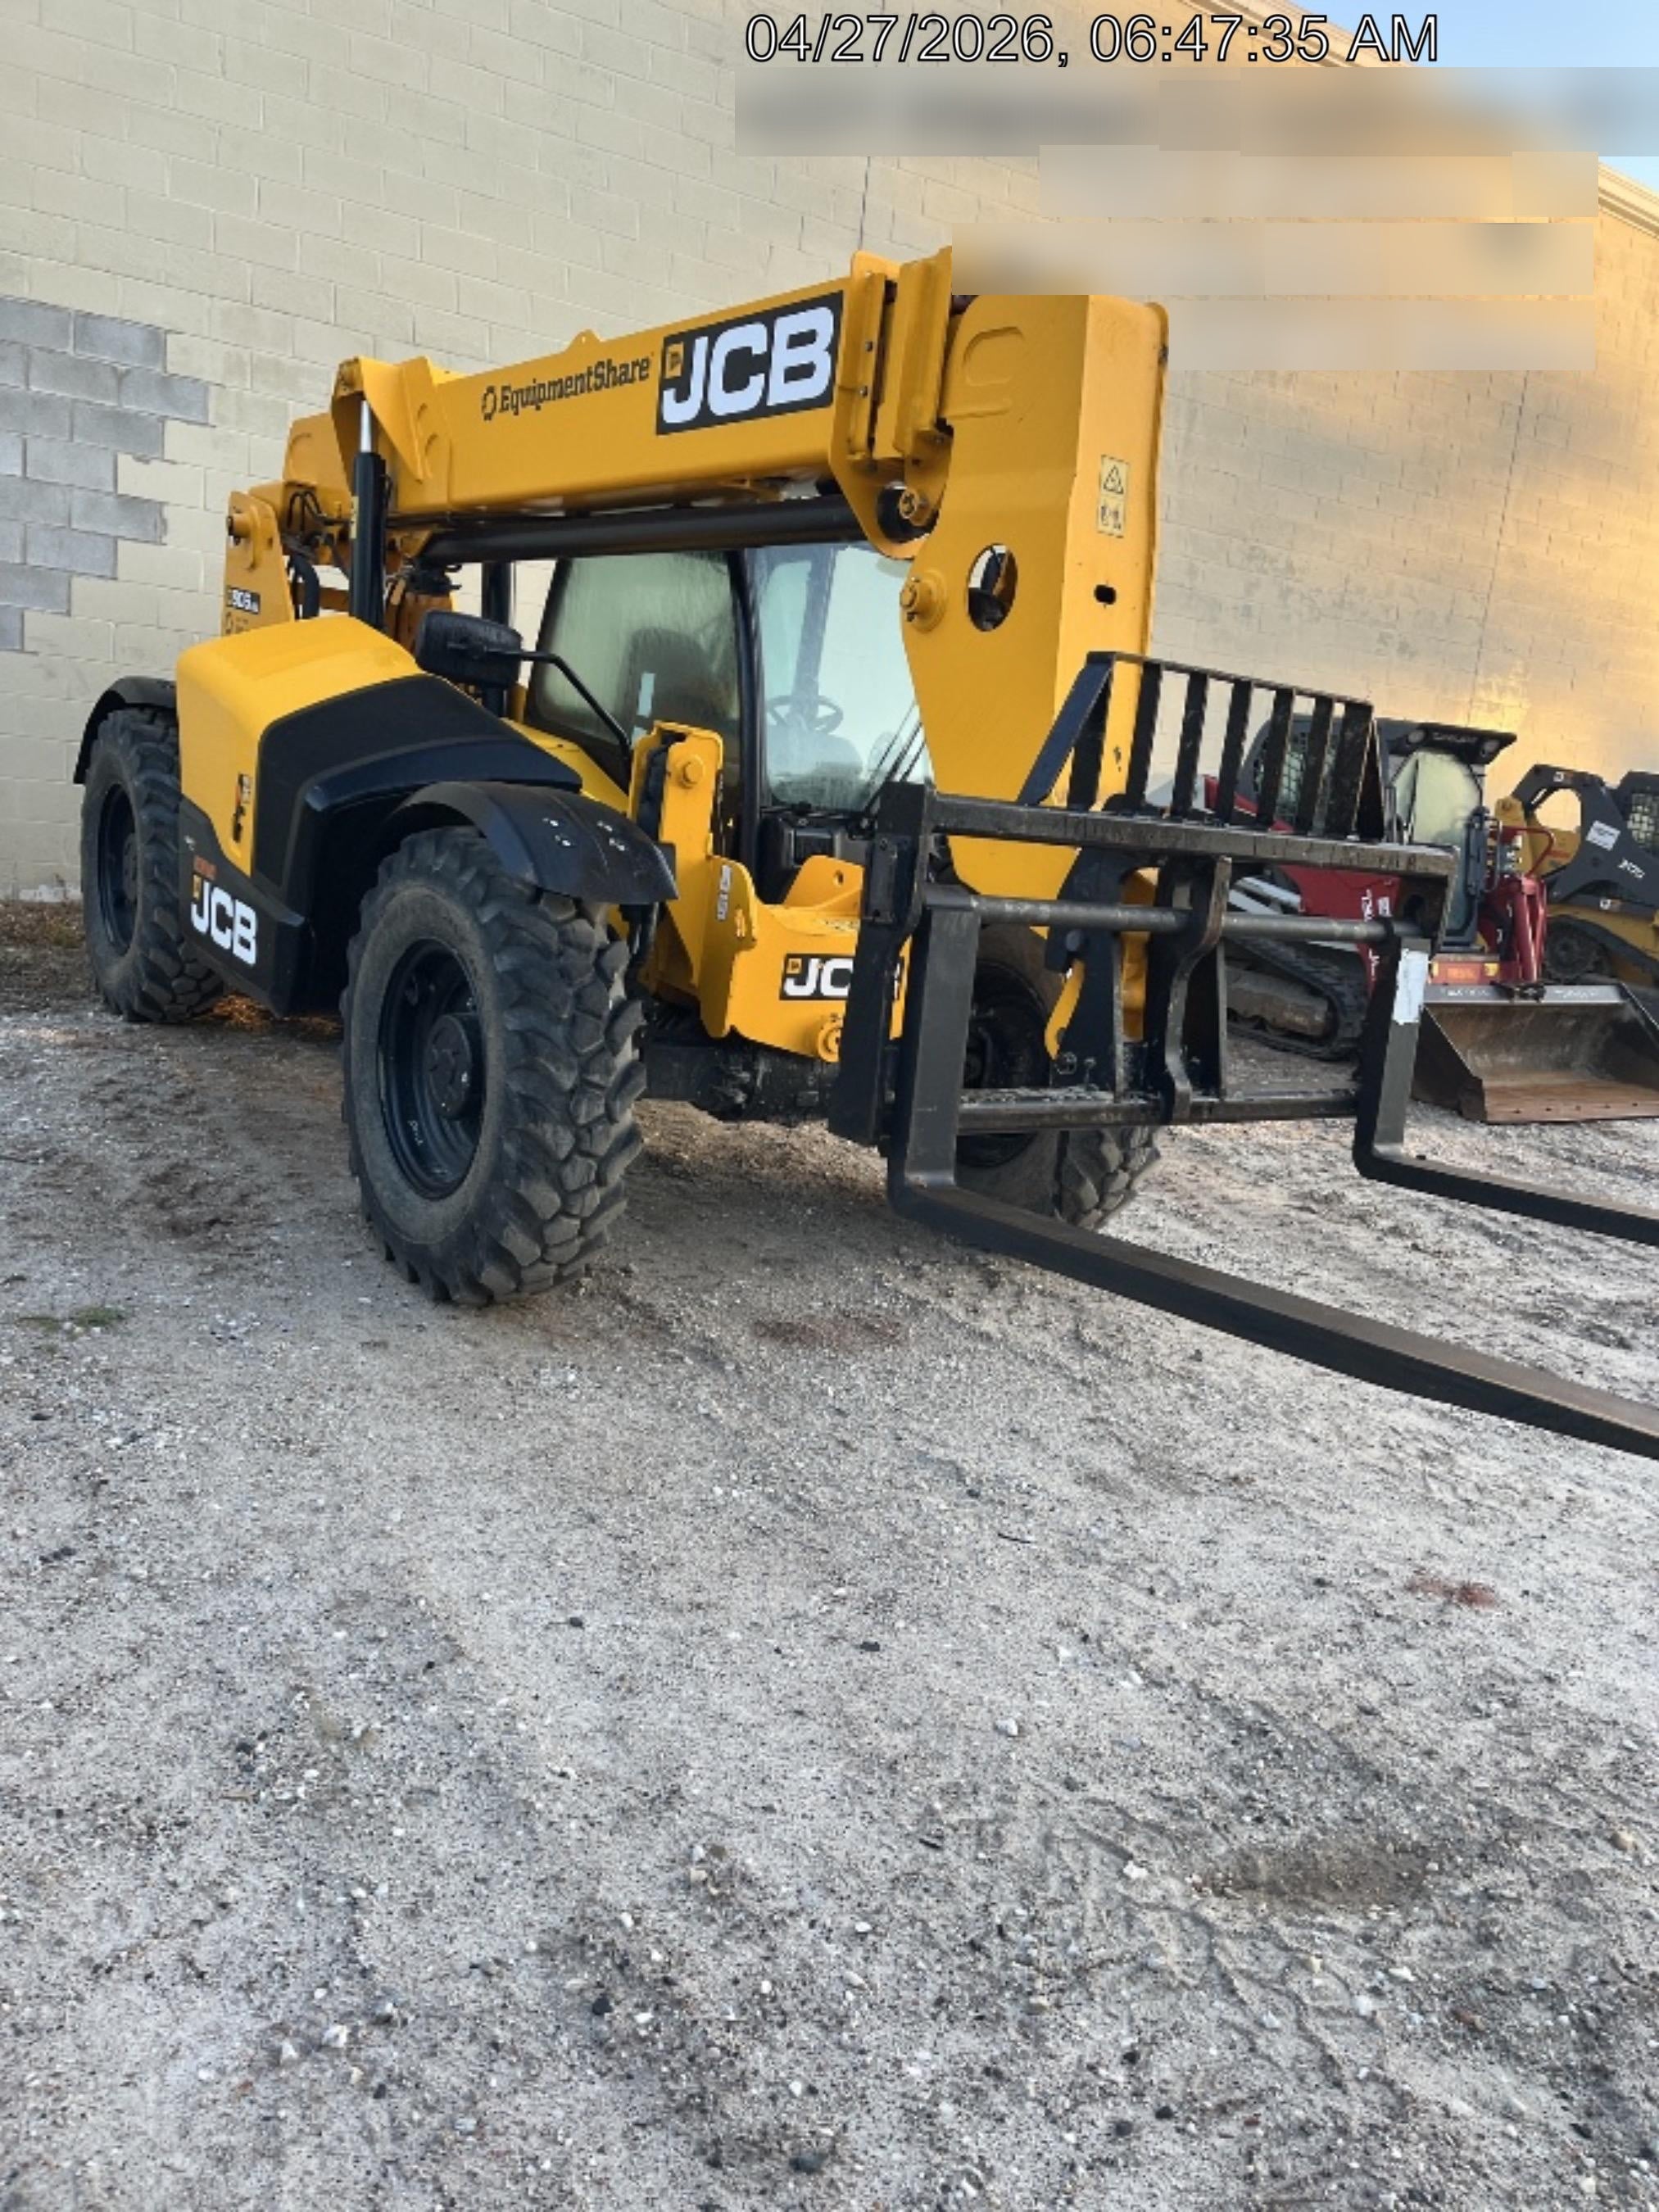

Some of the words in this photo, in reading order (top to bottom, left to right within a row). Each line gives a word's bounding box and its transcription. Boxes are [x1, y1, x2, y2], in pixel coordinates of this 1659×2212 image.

[499, 356, 650, 416] EquipmentShare
[662, 306, 835, 424] JCB
[191, 881, 256, 965] JCB
[783, 958, 900, 997] JC
